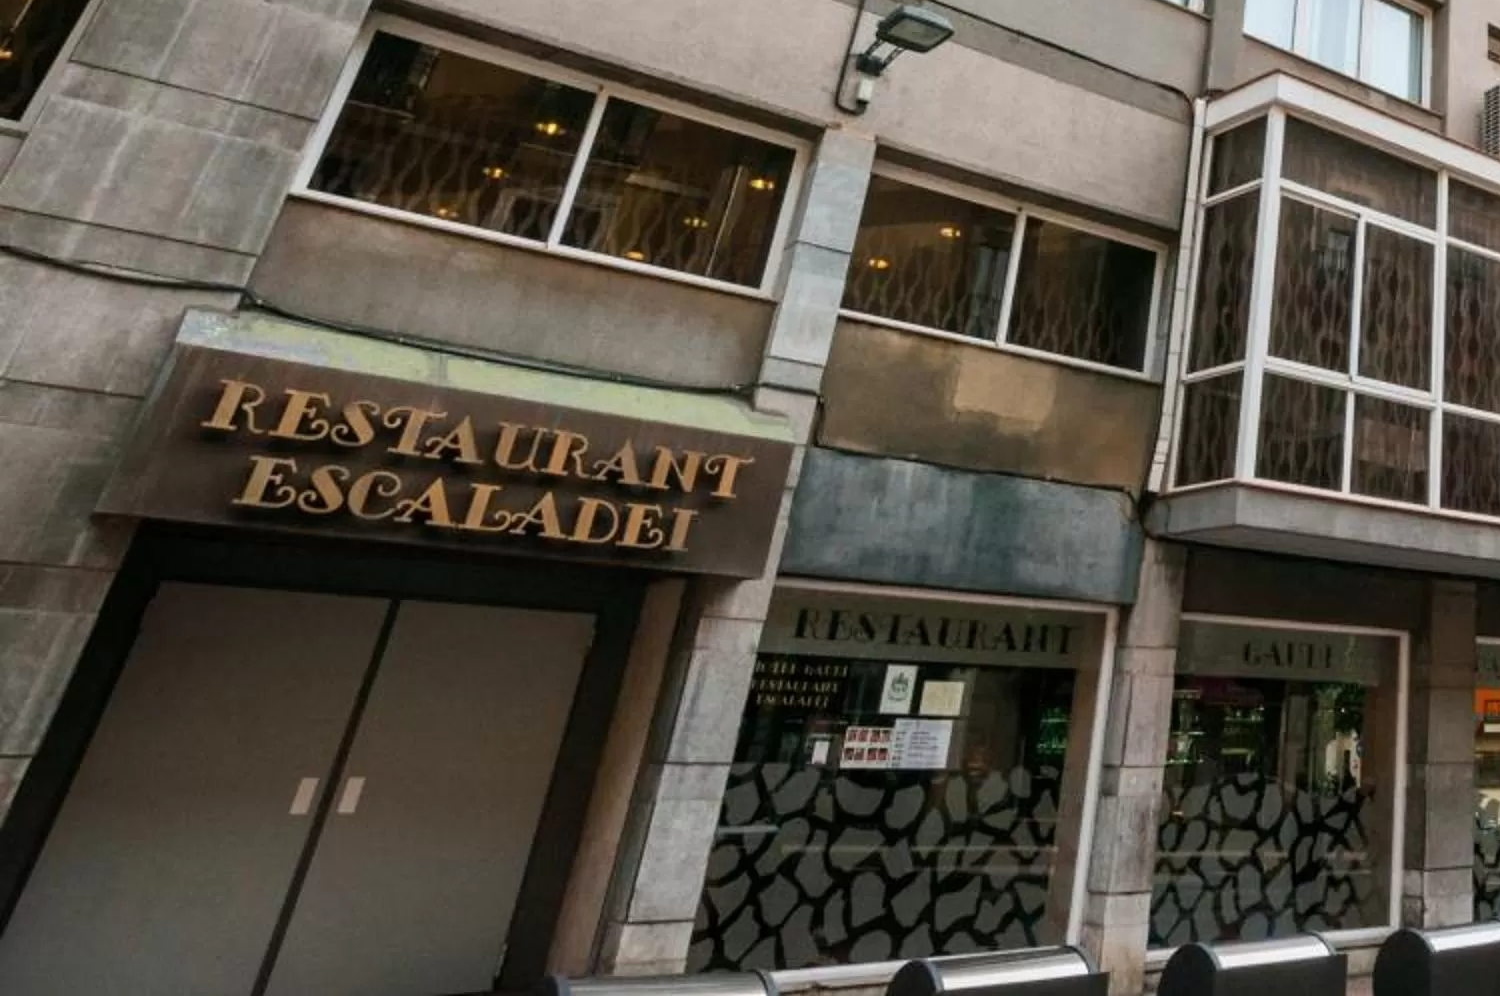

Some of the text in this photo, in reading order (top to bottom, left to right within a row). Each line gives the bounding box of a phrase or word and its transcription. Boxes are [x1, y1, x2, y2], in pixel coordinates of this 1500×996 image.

[201, 379, 756, 501] RESTAURANT
[232, 455, 700, 554] ESCALADEI
[792, 607, 1081, 655] RESTAURANT
